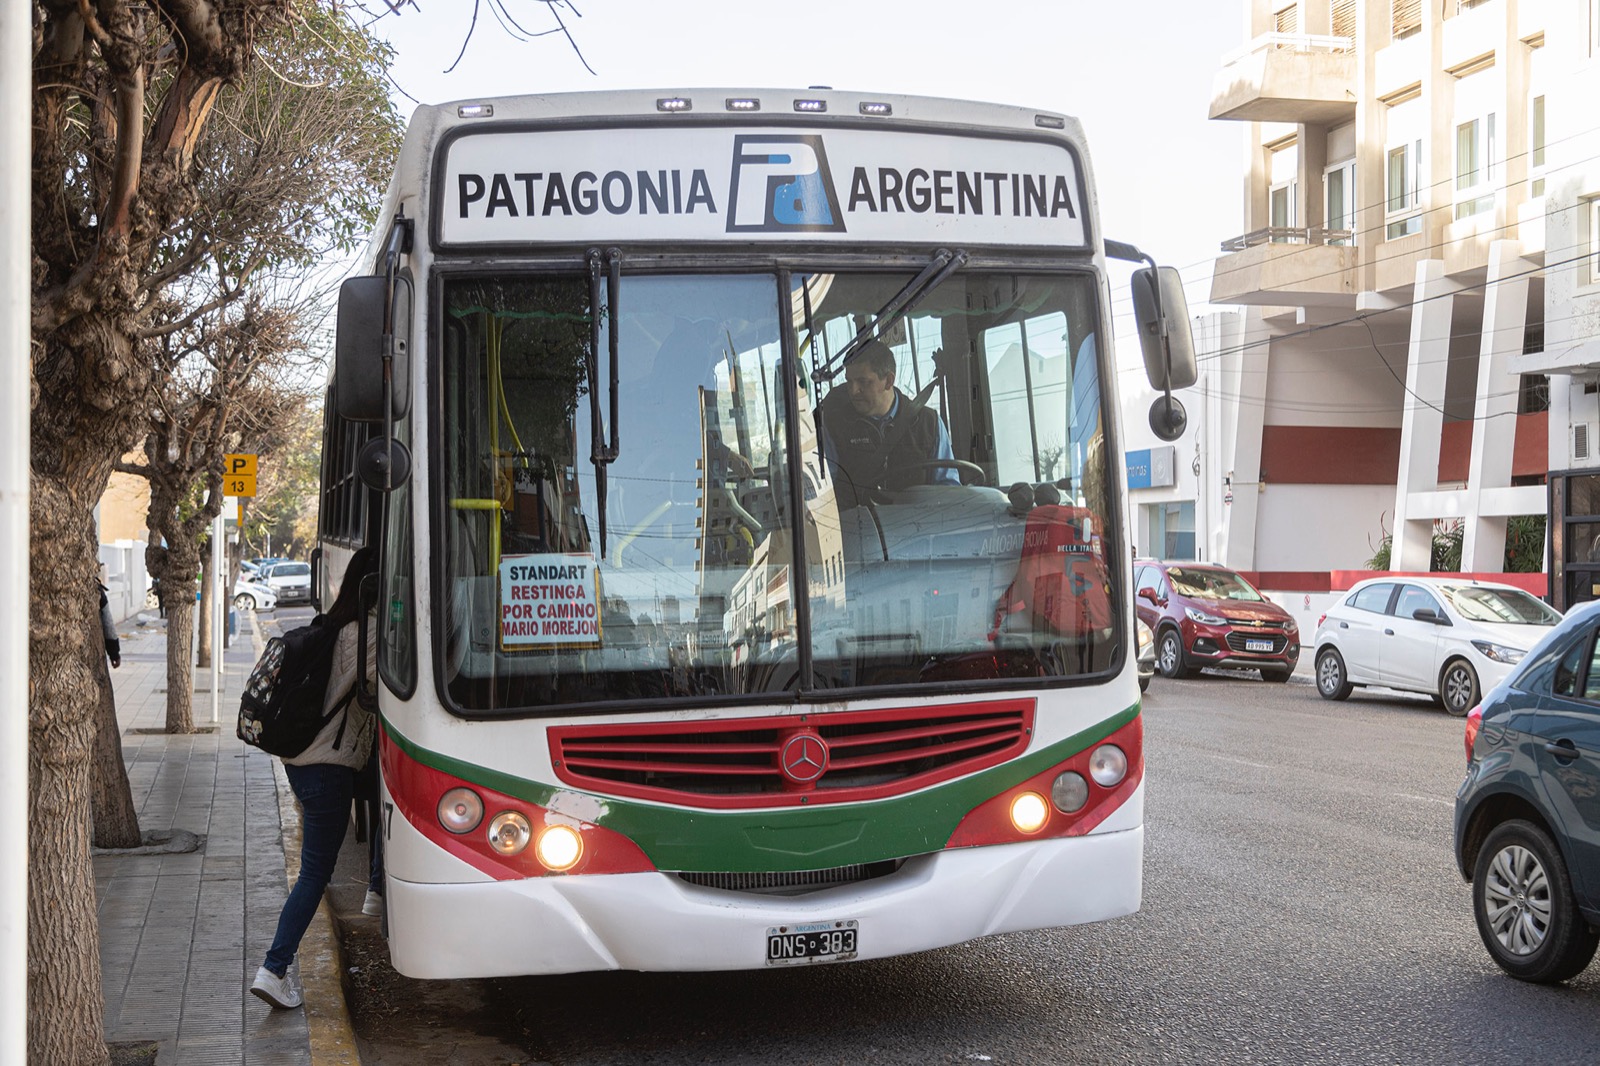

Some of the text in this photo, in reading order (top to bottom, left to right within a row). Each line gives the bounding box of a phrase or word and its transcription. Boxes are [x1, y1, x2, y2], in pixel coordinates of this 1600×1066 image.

[457, 168, 718, 219] PATAGONIA
[847, 166, 1077, 219] ARGENTINA
[232, 458, 247, 473] P
[230, 480, 245, 493] 13
[510, 565, 587, 581] STANDART
[511, 584, 586, 600] RESTINGA
[503, 603, 596, 619] POR CAMINO
[502, 620, 598, 637] MARIO MOREJON
[794, 923, 832, 932] ARGENTINA
[770, 930, 855, 959] ONS 383
